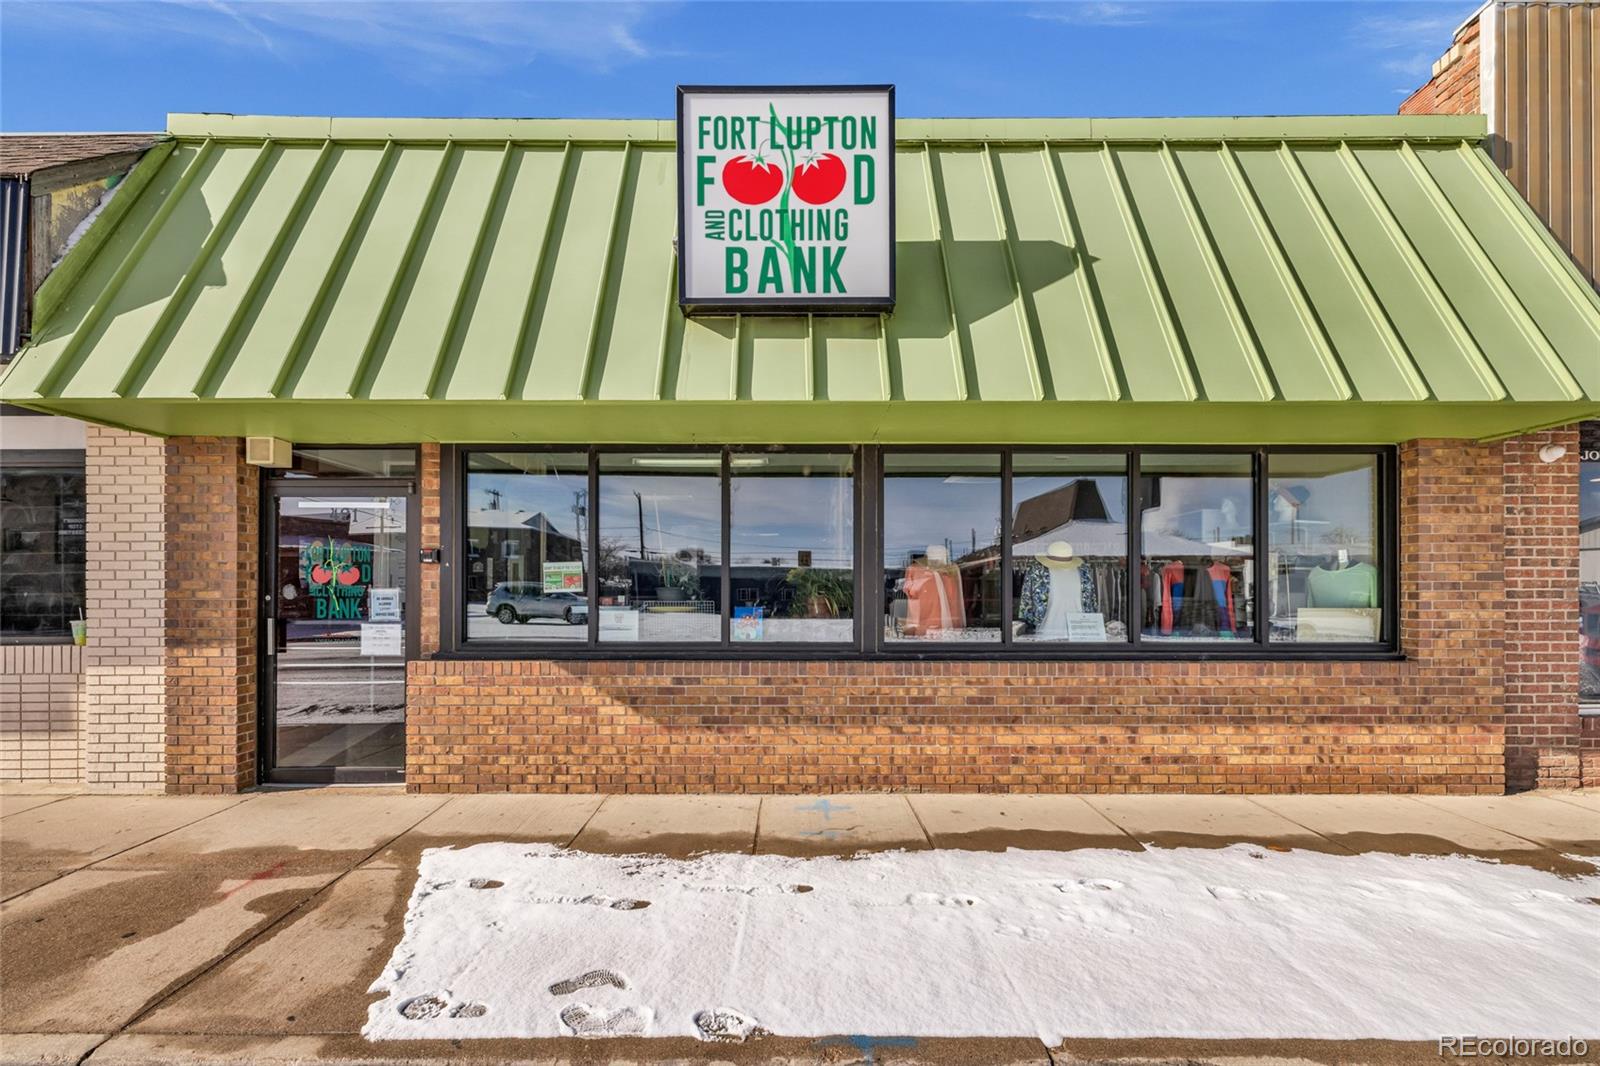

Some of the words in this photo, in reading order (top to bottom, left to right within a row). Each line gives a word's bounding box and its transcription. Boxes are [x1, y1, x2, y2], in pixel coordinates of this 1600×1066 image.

[698, 116, 760, 150] FORT
[770, 116, 877, 150] LUPTON
[705, 209, 725, 241] AND
[729, 208, 849, 241] CLOTHING
[725, 246, 848, 294] BANK
[316, 597, 362, 619] BANK
